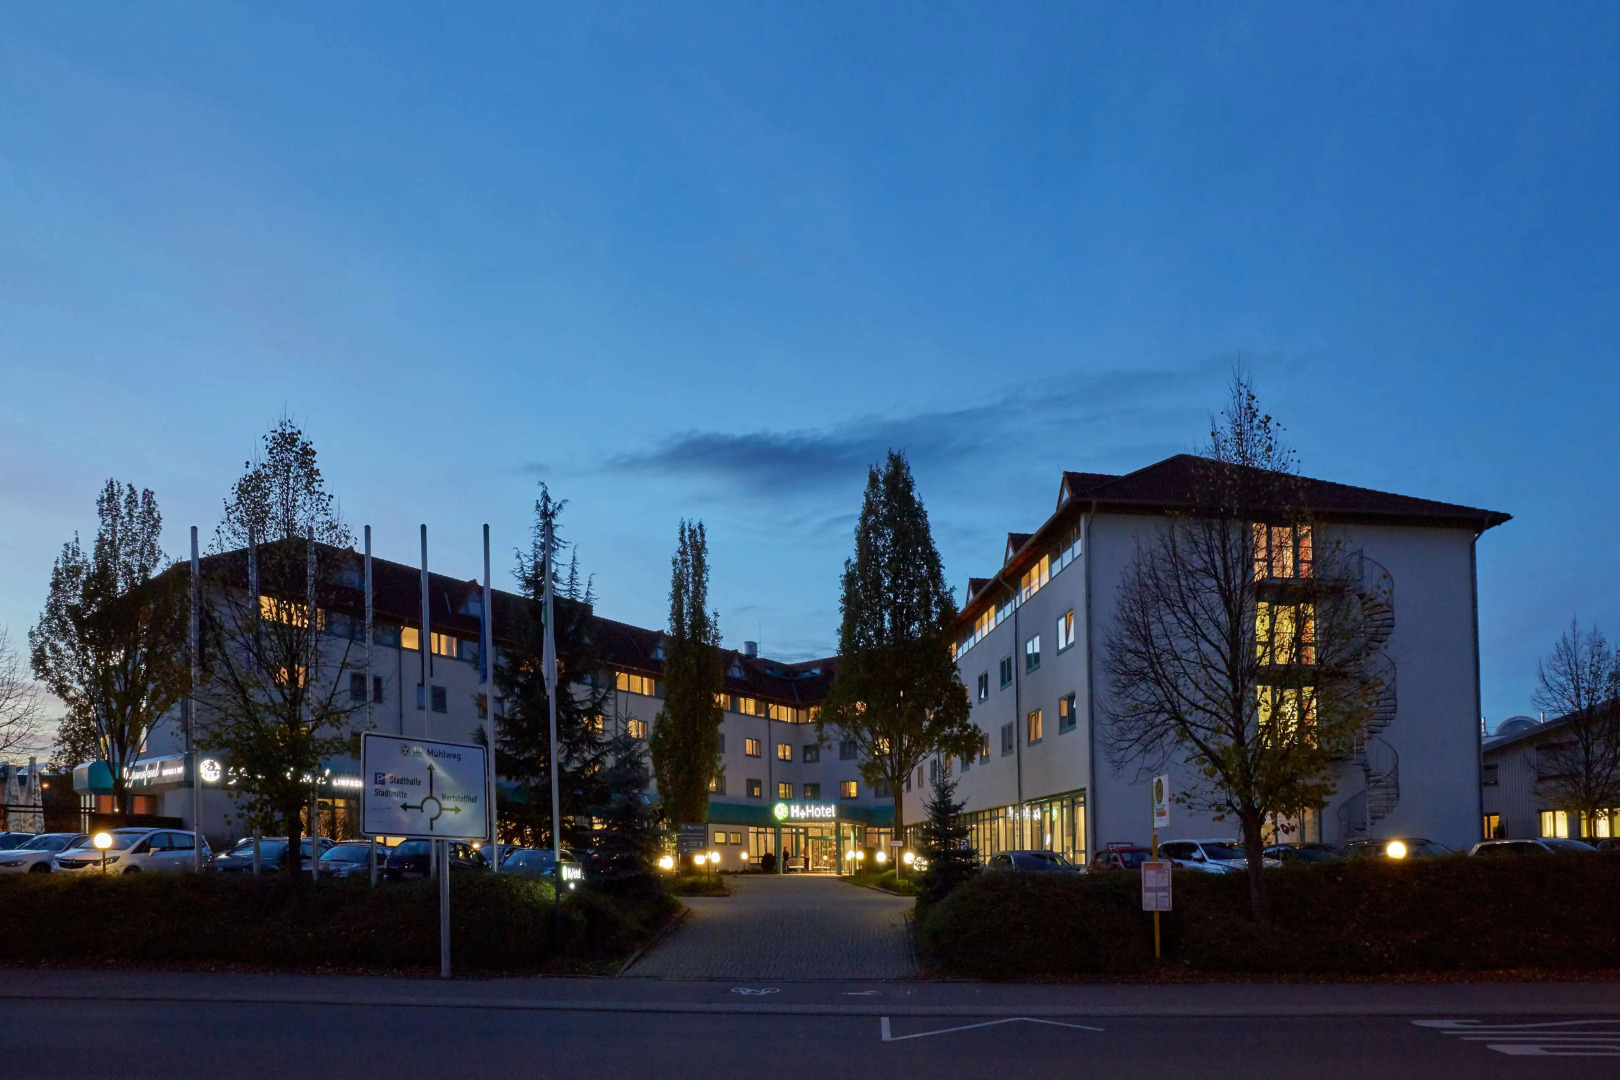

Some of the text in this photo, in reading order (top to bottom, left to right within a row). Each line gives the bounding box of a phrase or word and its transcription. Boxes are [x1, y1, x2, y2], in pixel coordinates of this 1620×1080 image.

[427, 748, 462, 762] Mühlweg
[389, 775, 421, 786] Stadthalle
[374, 788, 407, 799] Stadtmitte
[441, 792, 478, 804] Wertstoffhof
[790, 804, 836, 819] H+Hotel
